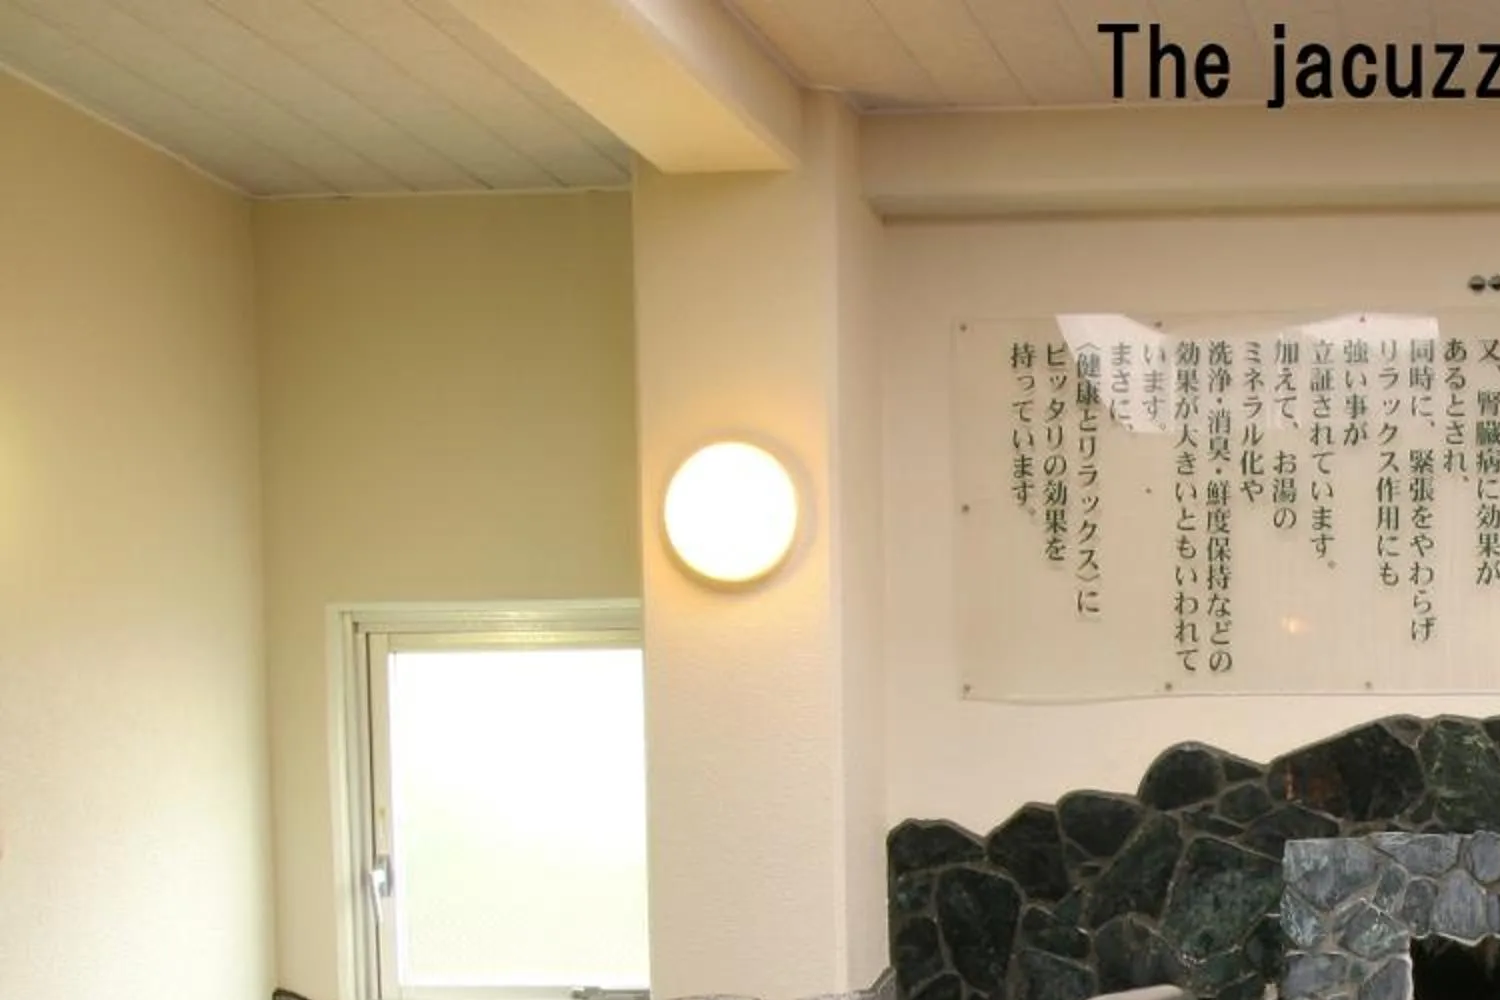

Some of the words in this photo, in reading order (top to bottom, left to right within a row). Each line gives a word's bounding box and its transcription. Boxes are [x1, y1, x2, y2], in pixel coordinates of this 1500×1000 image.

[1143, 344, 1167, 432] います。
[1240, 340, 1265, 502] ミネラル化や
[1309, 340, 1336, 570] 立証されています。
[1343, 340, 1369, 446] 強い事が
[1376, 338, 1402, 587] リラックス作用にも
[1444, 337, 1469, 483] あるとされ、
[1174, 341, 1200, 673] 効果が大きいともいわれて
